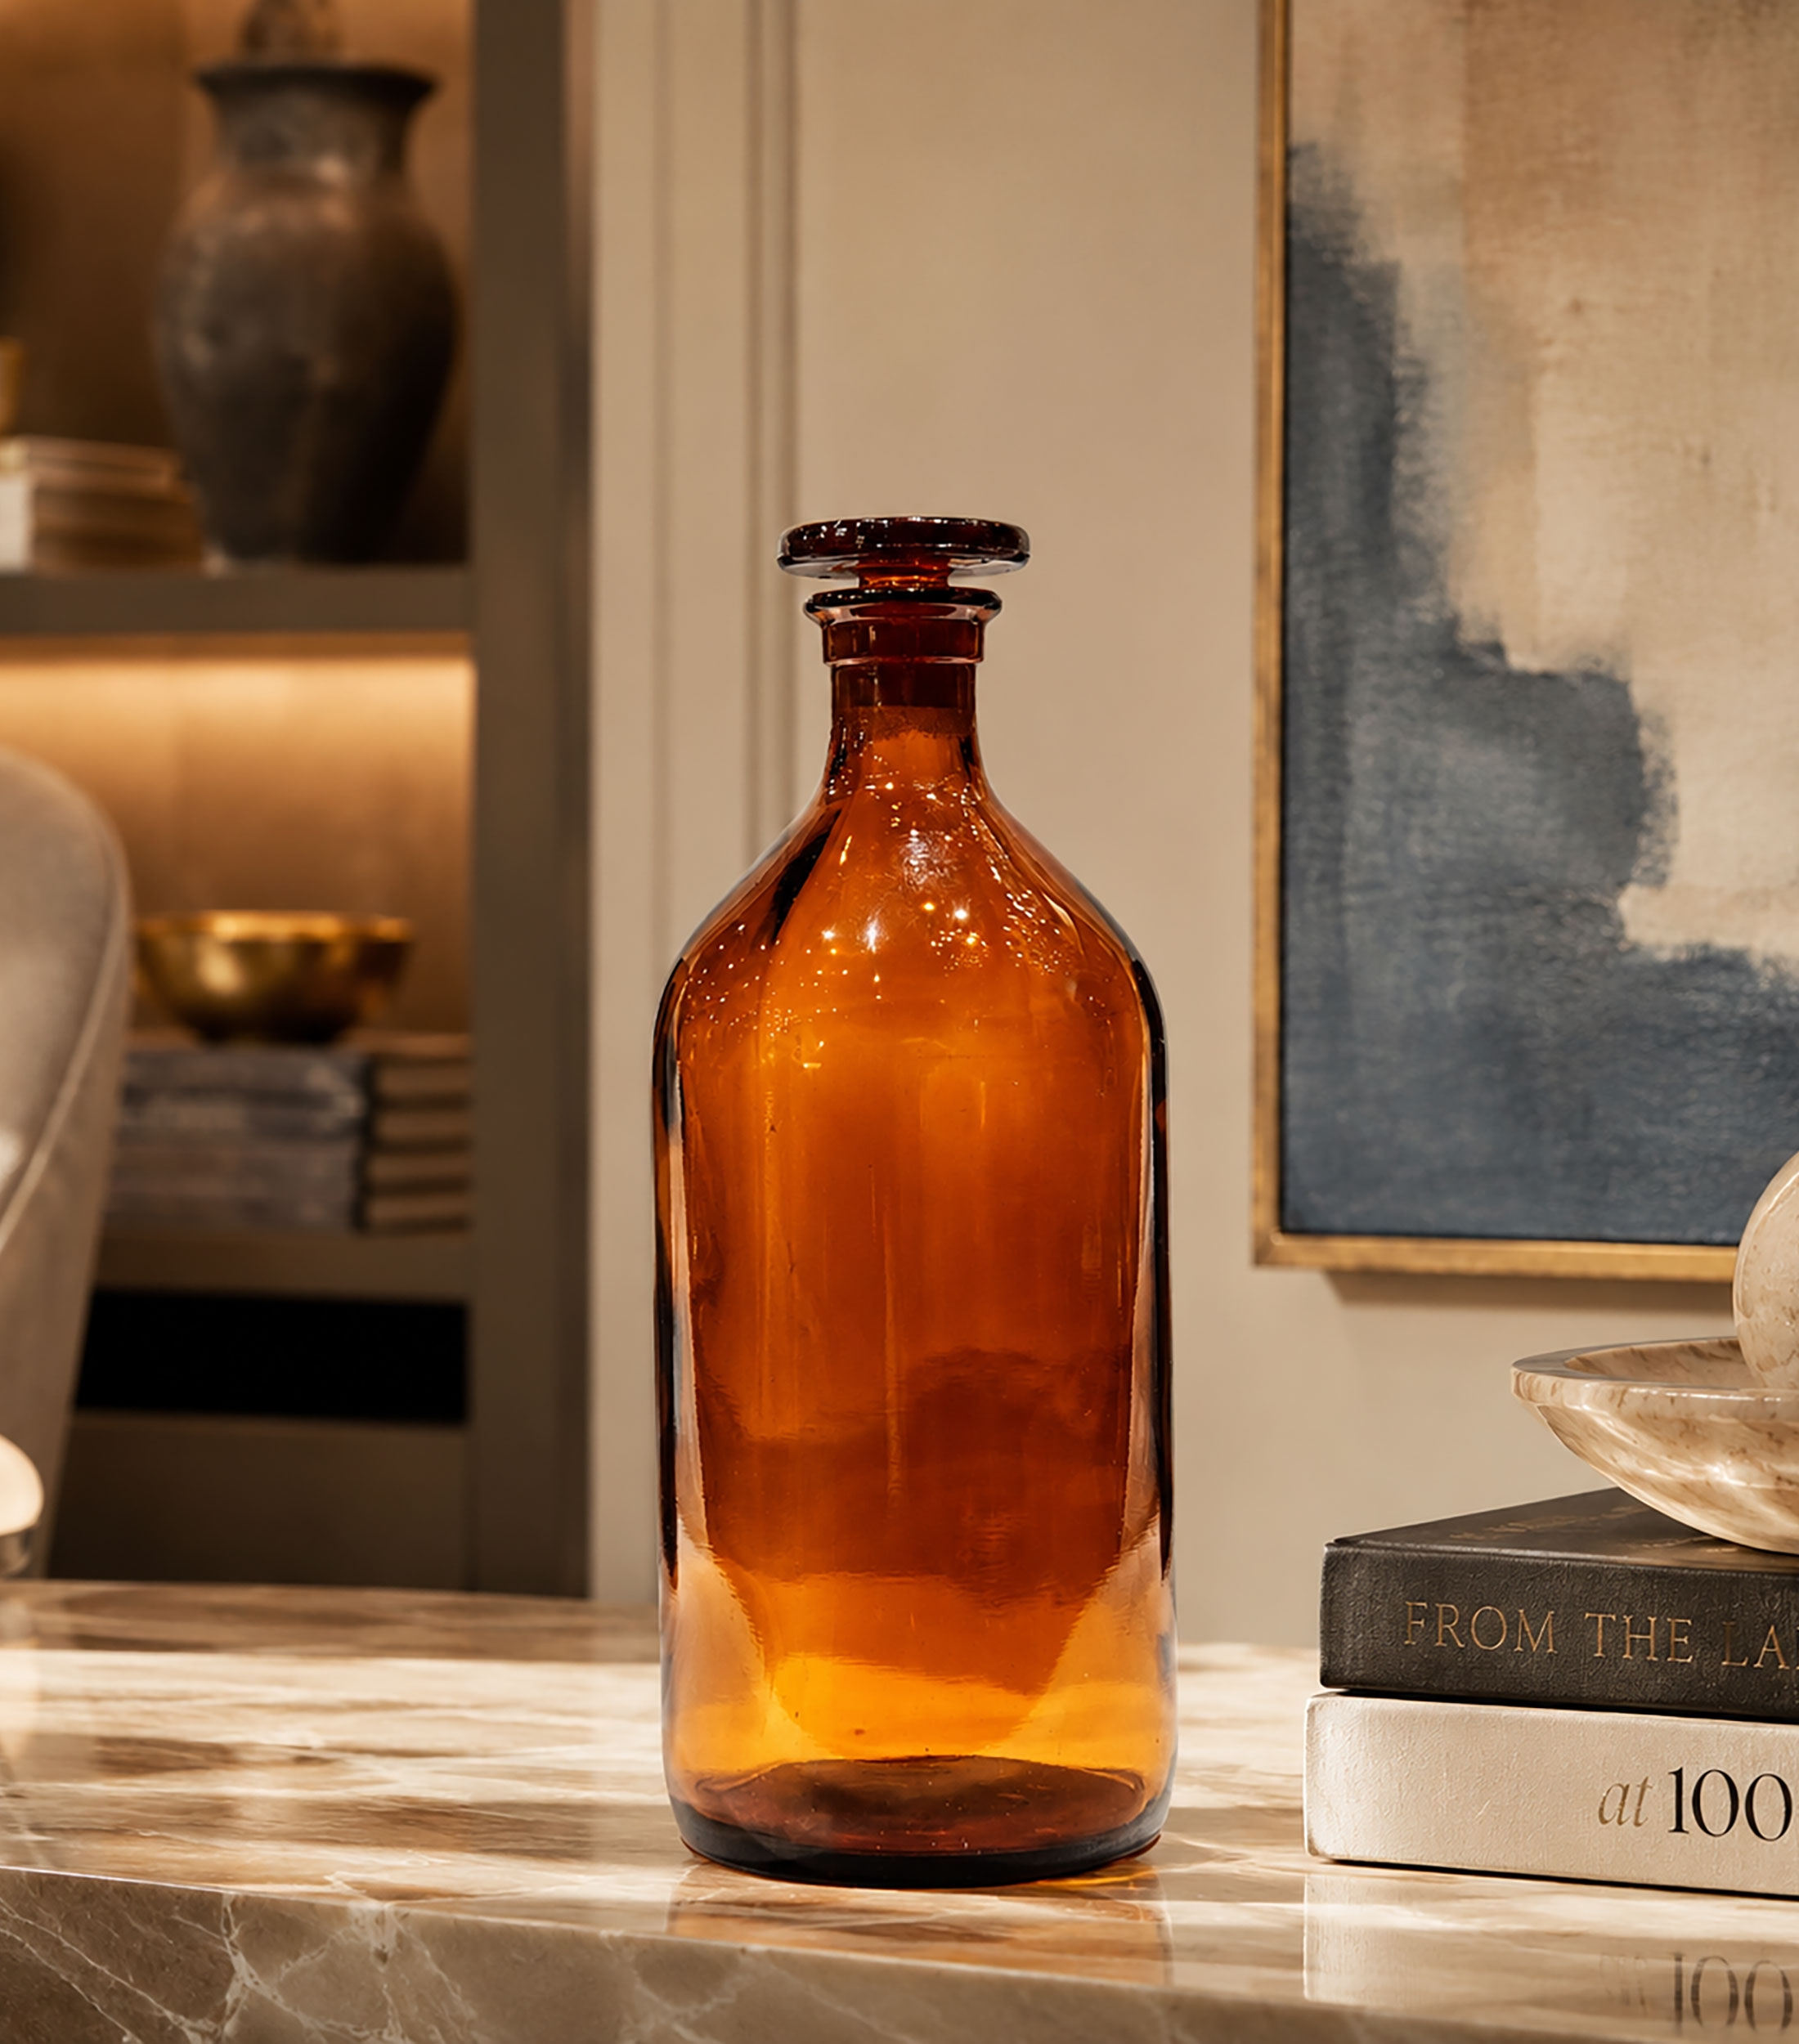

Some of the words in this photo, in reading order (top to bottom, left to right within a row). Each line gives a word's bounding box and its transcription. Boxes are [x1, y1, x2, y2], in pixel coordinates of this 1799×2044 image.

[1403, 1601, 1558, 1654] FROM
[1585, 1612, 1693, 1663] THE
[1721, 1621, 1799, 1670] LA
[1598, 1776, 1653, 1827] at
[1668, 1766, 1793, 1842] 100
